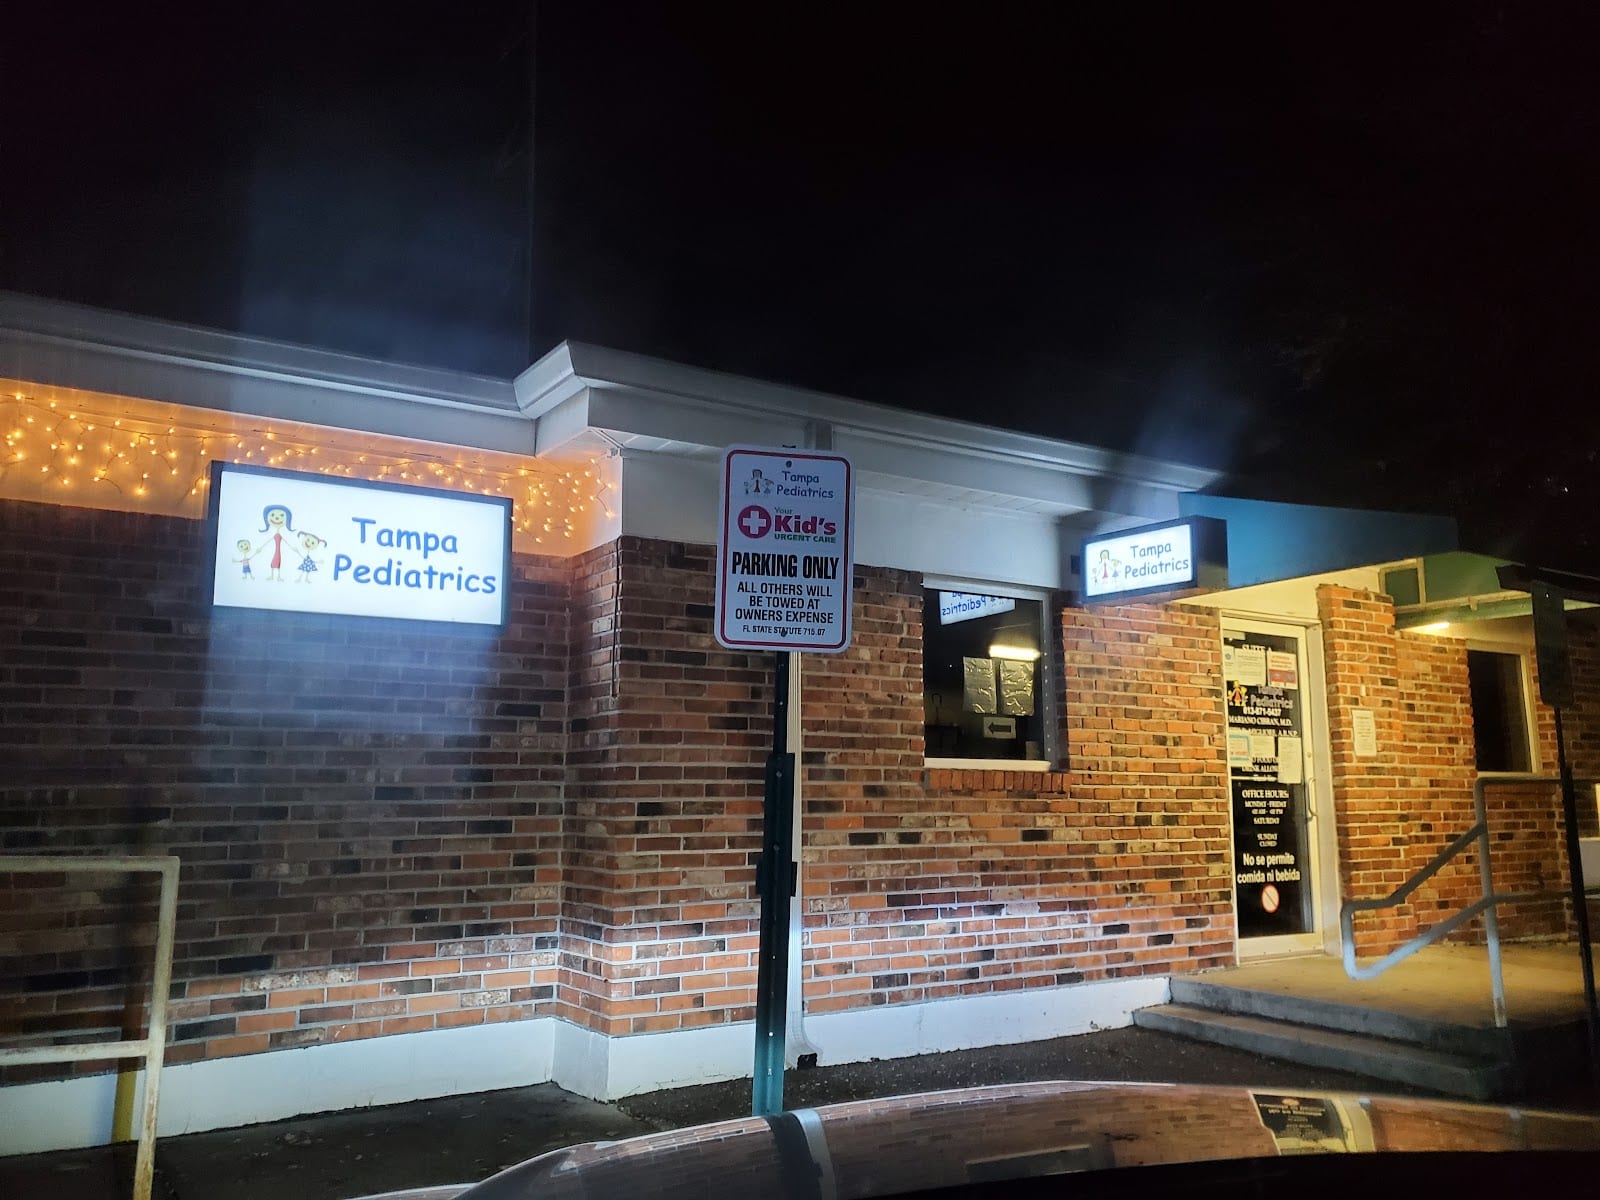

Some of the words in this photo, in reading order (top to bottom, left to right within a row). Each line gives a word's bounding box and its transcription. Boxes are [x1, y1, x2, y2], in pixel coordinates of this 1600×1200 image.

[782, 470, 819, 486] Tampa
[776, 484, 834, 498] Pediatrics
[775, 515, 836, 535] Kid's
[351, 516, 458, 559] Tampa
[774, 534, 811, 542] URGENT
[813, 536, 836, 544] CARE
[1130, 543, 1171, 558] Tampa
[332, 553, 496, 594] Pediatrics
[732, 552, 798, 578] PARKING
[802, 555, 840, 580] ONLY
[1124, 558, 1189, 578] Pediatrics
[737, 581, 757, 593] ALL
[760, 582, 803, 596] OTHERS
[806, 585, 833, 597] WILL
[749, 595, 763, 607] BE
[766, 596, 804, 609] TOWED
[807, 599, 820, 610] AT
[735, 608, 782, 621] OWNERS
[786, 610, 834, 624] EXPENSE
[752, 625, 772, 633] STATE
[773, 626, 802, 635] STATUTE
[1250, 694, 1293, 709] Pediatrics
[1241, 789, 1264, 798] OFFICE
[1269, 800, 1287, 808] FRIDAY
[1243, 853, 1255, 866] No
[1256, 855, 1265, 866] se
[1266, 851, 1295, 868] permite
[1237, 870, 1265, 884] comida
[1267, 869, 1274, 882] ni
[1275, 868, 1301, 882] bebida
